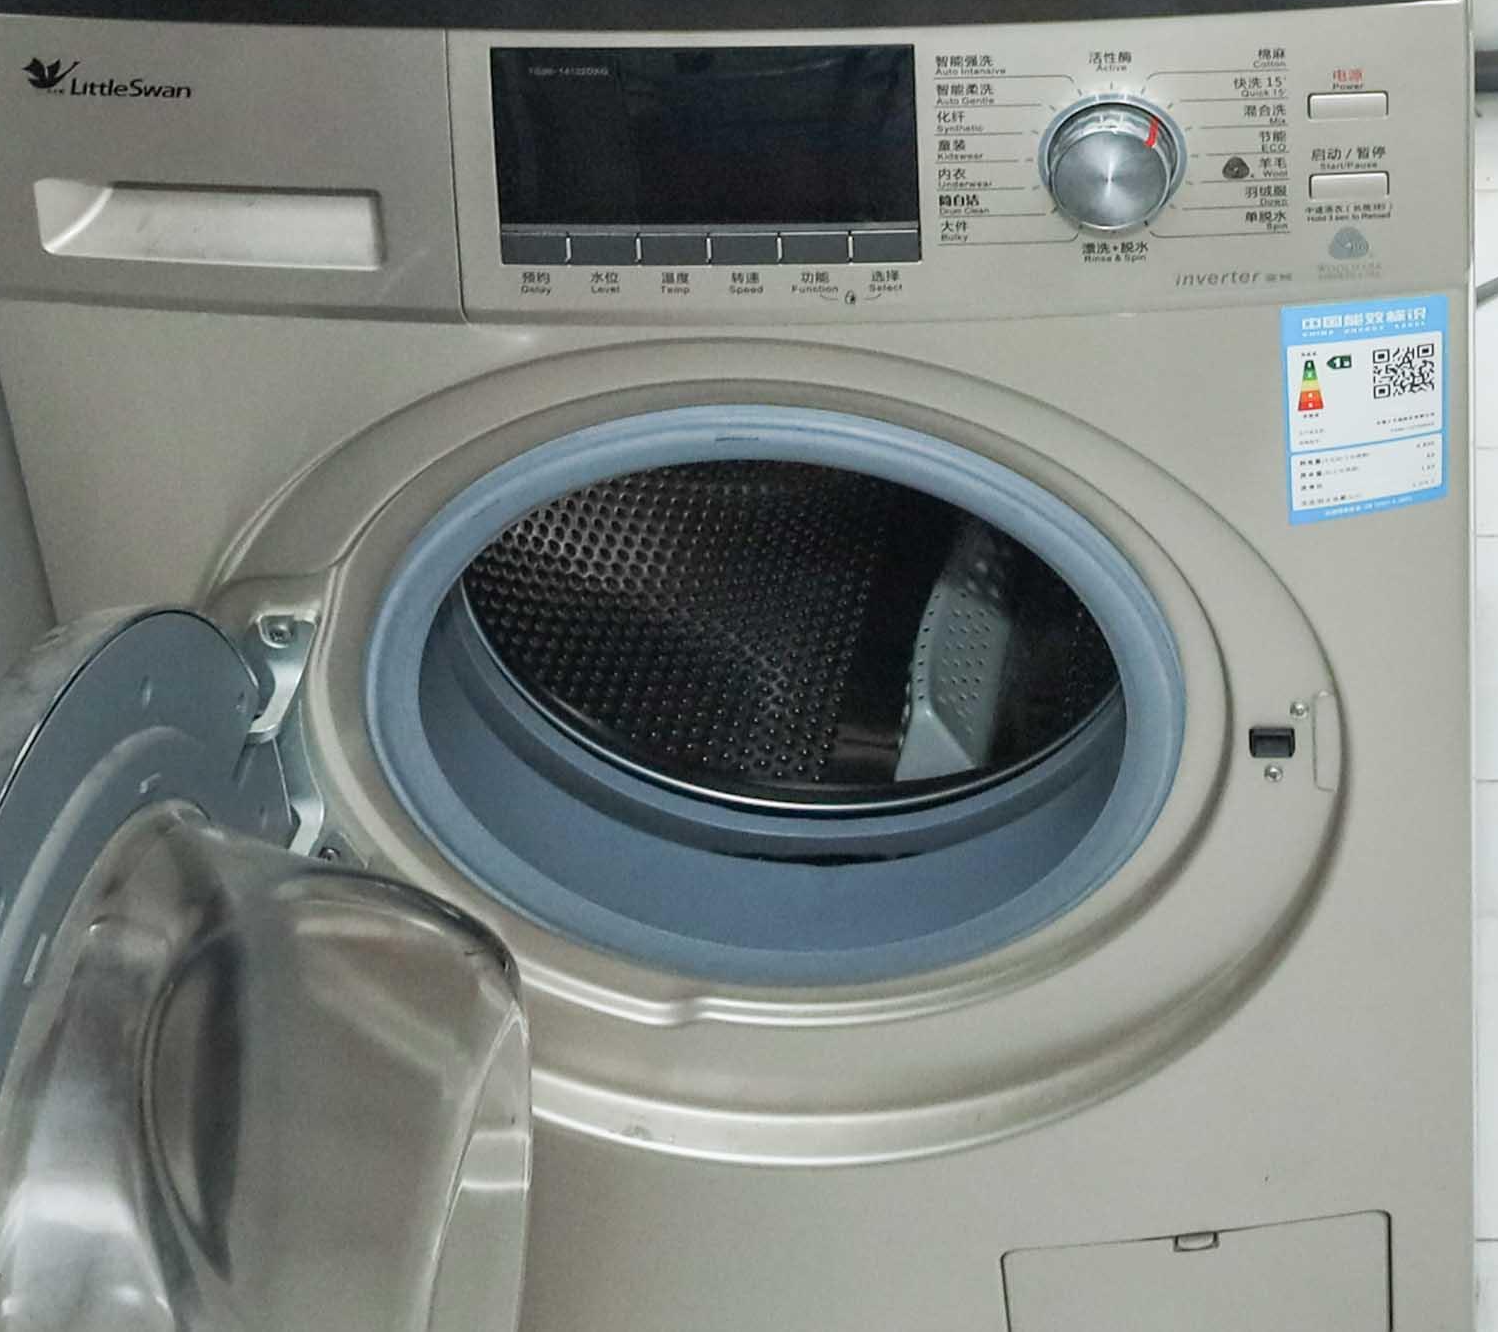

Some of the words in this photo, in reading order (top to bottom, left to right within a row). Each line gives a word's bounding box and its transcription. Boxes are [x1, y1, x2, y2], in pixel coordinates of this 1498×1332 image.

[1089, 51, 1132, 64] 活性酶
[1258, 48, 1286, 60] 棉麻
[935, 55, 994, 67] 智能强洗
[1253, 60, 1286, 68] Cotton
[961, 67, 1006, 75] Intensive
[1096, 64, 1127, 72] Active
[1332, 68, 1365, 83] 电源
[70, 78, 192, 99] LittleSwan
[1234, 77, 1262, 89] 快洗
[1333, 82, 1364, 90] Power
[936, 84, 994, 96] 智能柔洗
[1241, 89, 1270, 98] Quick
[936, 97, 959, 105] Auto
[1244, 105, 1286, 117] 混合洗
[937, 125, 984, 133] Synthetic
[1260, 131, 1286, 143] 节能
[1261, 144, 1286, 152] ECO
[1260, 156, 1286, 169] 羊毛
[1320, 162, 1378, 170] Start/Pause
[938, 168, 966, 179] 内衣
[1263, 169, 1287, 177] Wool
[938, 180, 993, 188] Underwear
[1245, 186, 1287, 198] 羽绒服
[964, 206, 990, 214] Clean
[1245, 211, 1287, 223] 单脱水
[942, 220, 967, 232] 大件
[942, 234, 968, 242] Bulky
[1084, 255, 1112, 263] Rinse
[1124, 254, 1146, 263] Spin
[523, 271, 550, 284] 预约
[590, 271, 619, 284] 水位
[661, 271, 689, 284] 温度
[731, 271, 760, 284] 转速
[801, 270, 829, 284] 功能
[871, 269, 900, 283] 选择
[1175, 270, 1260, 286] inverter
[521, 285, 552, 296] Delay
[591, 284, 620, 294] Level
[661, 285, 690, 295] Temp
[729, 285, 763, 295] Speed
[792, 284, 839, 294] Function
[869, 283, 903, 293] Select
[1302, 306, 1426, 330] 中国能效标识
